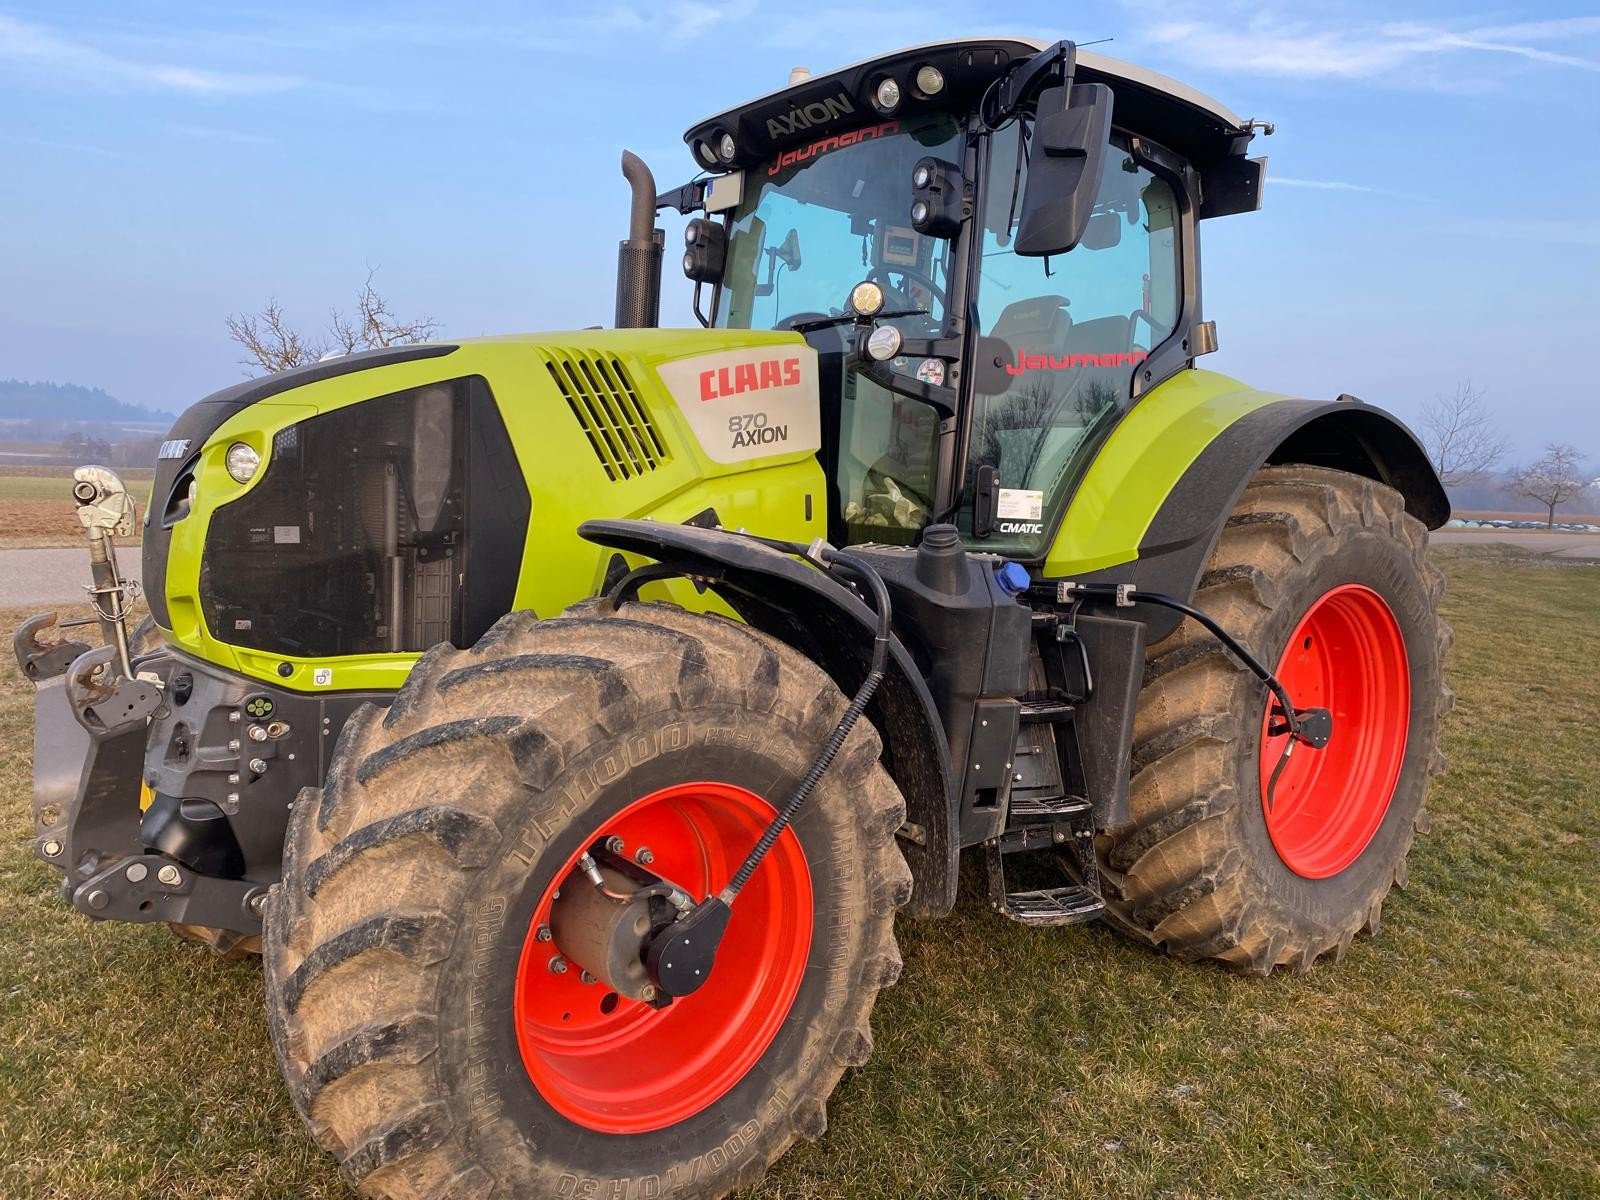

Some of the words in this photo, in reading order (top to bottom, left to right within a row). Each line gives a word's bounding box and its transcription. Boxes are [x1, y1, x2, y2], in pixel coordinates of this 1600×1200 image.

[766, 93, 855, 139] AXION
[768, 121, 900, 175] Jaumann
[1006, 348, 1147, 375] Jaumann
[699, 358, 800, 401] CLAAS
[729, 412, 768, 433] 870
[732, 425, 787, 448] AXION
[1000, 522, 1043, 534] CMATIC
[502, 721, 691, 867] TM1000
